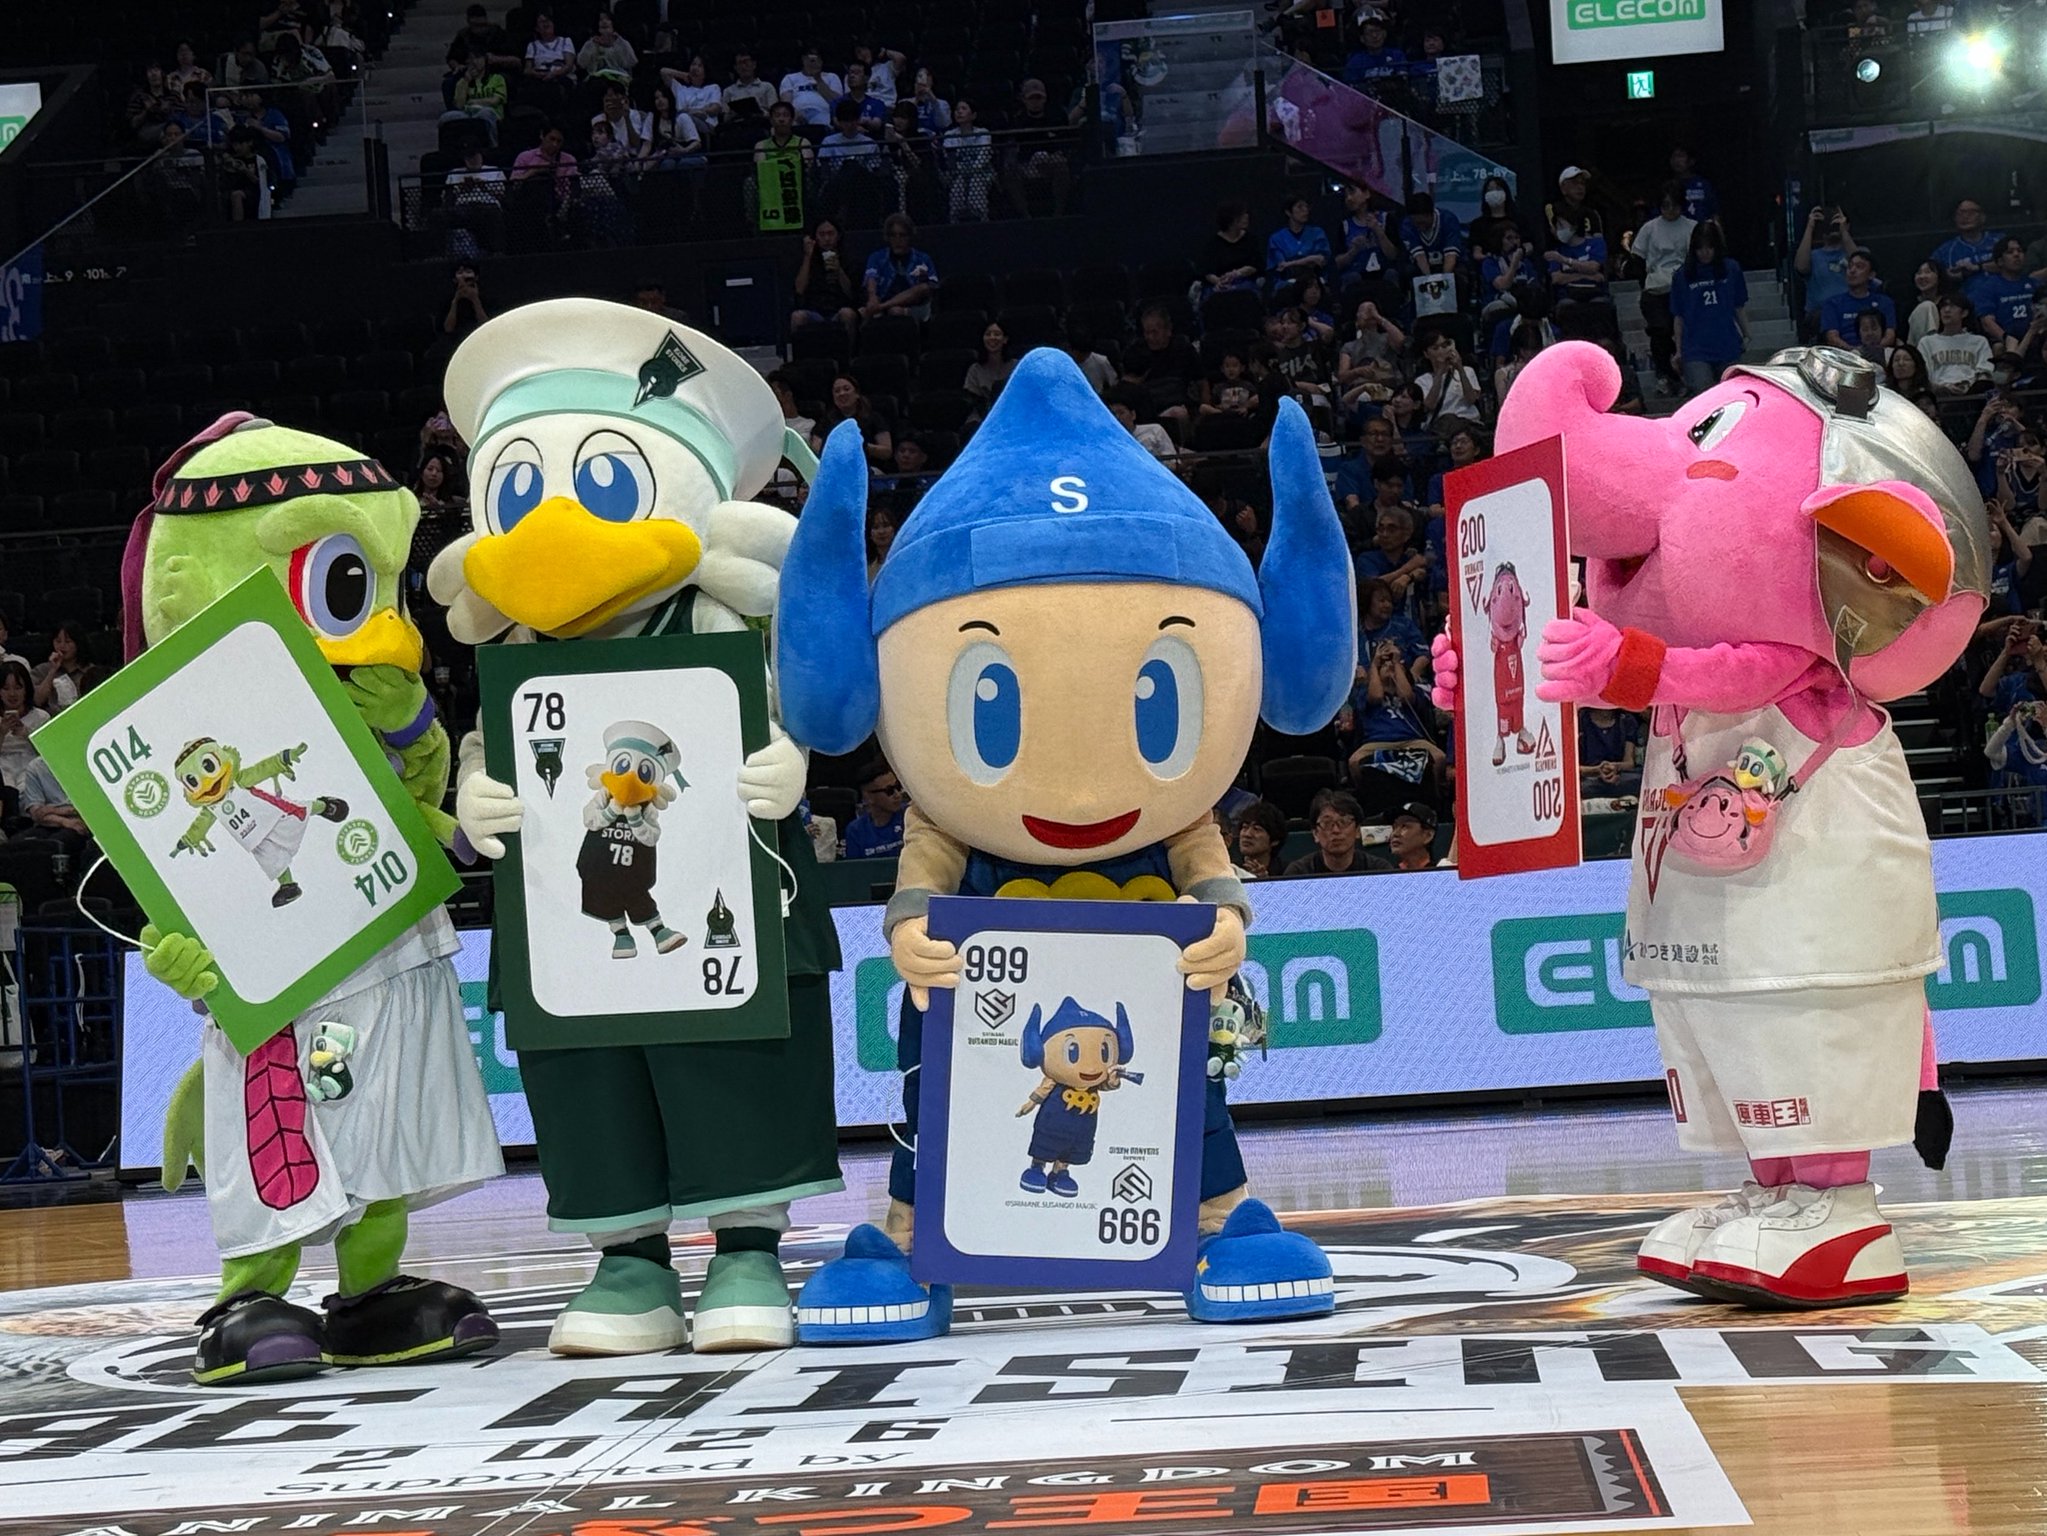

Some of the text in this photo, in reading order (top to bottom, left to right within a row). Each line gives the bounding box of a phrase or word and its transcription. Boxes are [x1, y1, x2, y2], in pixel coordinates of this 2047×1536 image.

[1575, 0, 1698, 23] ELECOM
[1703, 290, 1719, 306] 21
[2012, 304, 2028, 319] 22
[1050, 475, 1089, 514] S
[1460, 513, 1486, 559] 200
[523, 691, 566, 733] 78
[93, 724, 153, 784] 014
[229, 808, 251, 831] 014
[601, 827, 635, 842] STOR
[610, 842, 634, 867] 78
[353, 850, 408, 908] 014
[702, 955, 745, 996] 78
[965, 945, 1029, 984] 999
[54, 1450, 1477, 1536] ANIMAL KINGDOM
[264, 1451, 912, 1497] Supported by
